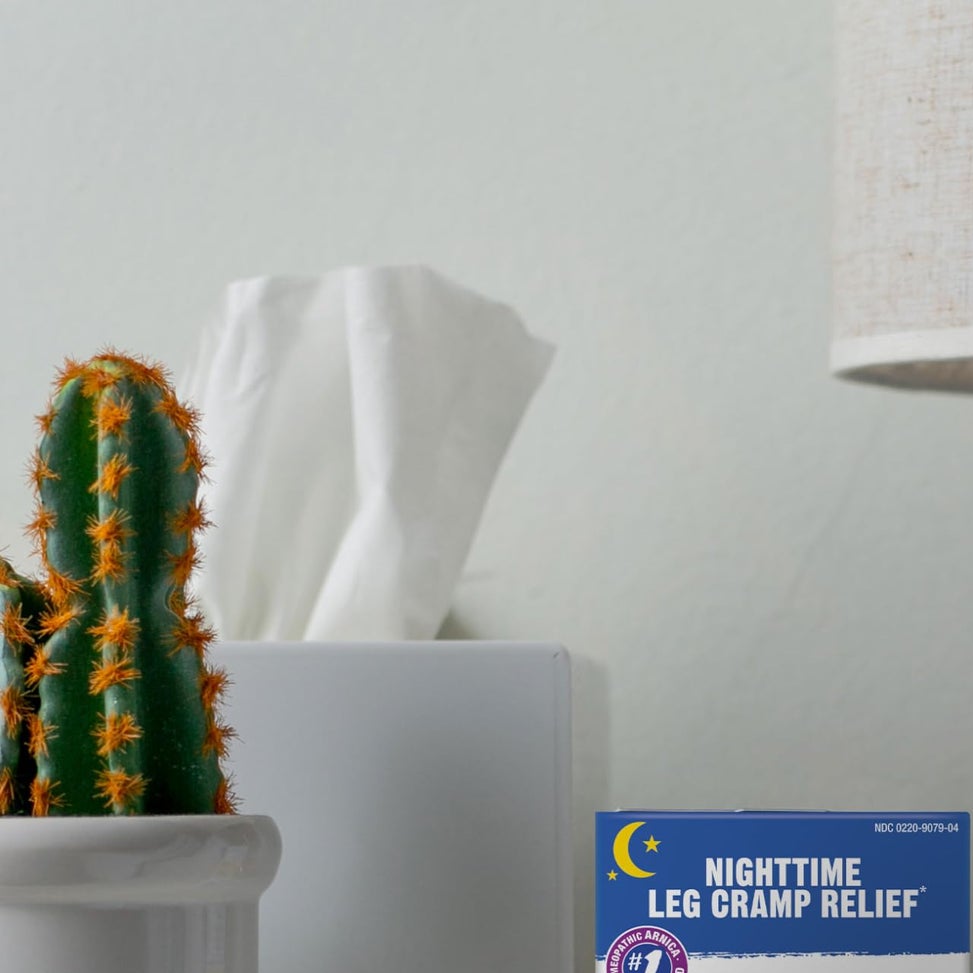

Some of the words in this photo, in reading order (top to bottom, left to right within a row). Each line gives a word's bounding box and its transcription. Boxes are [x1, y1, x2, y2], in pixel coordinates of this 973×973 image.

[874, 823, 894, 833] NDC
[896, 823, 959, 833] 0220-9079-04
[705, 857, 862, 887] NIGHTTIME
[648, 889, 700, 918] LEG
[711, 889, 811, 918] CRAMP
[644, 930, 681, 958] ARNICA
